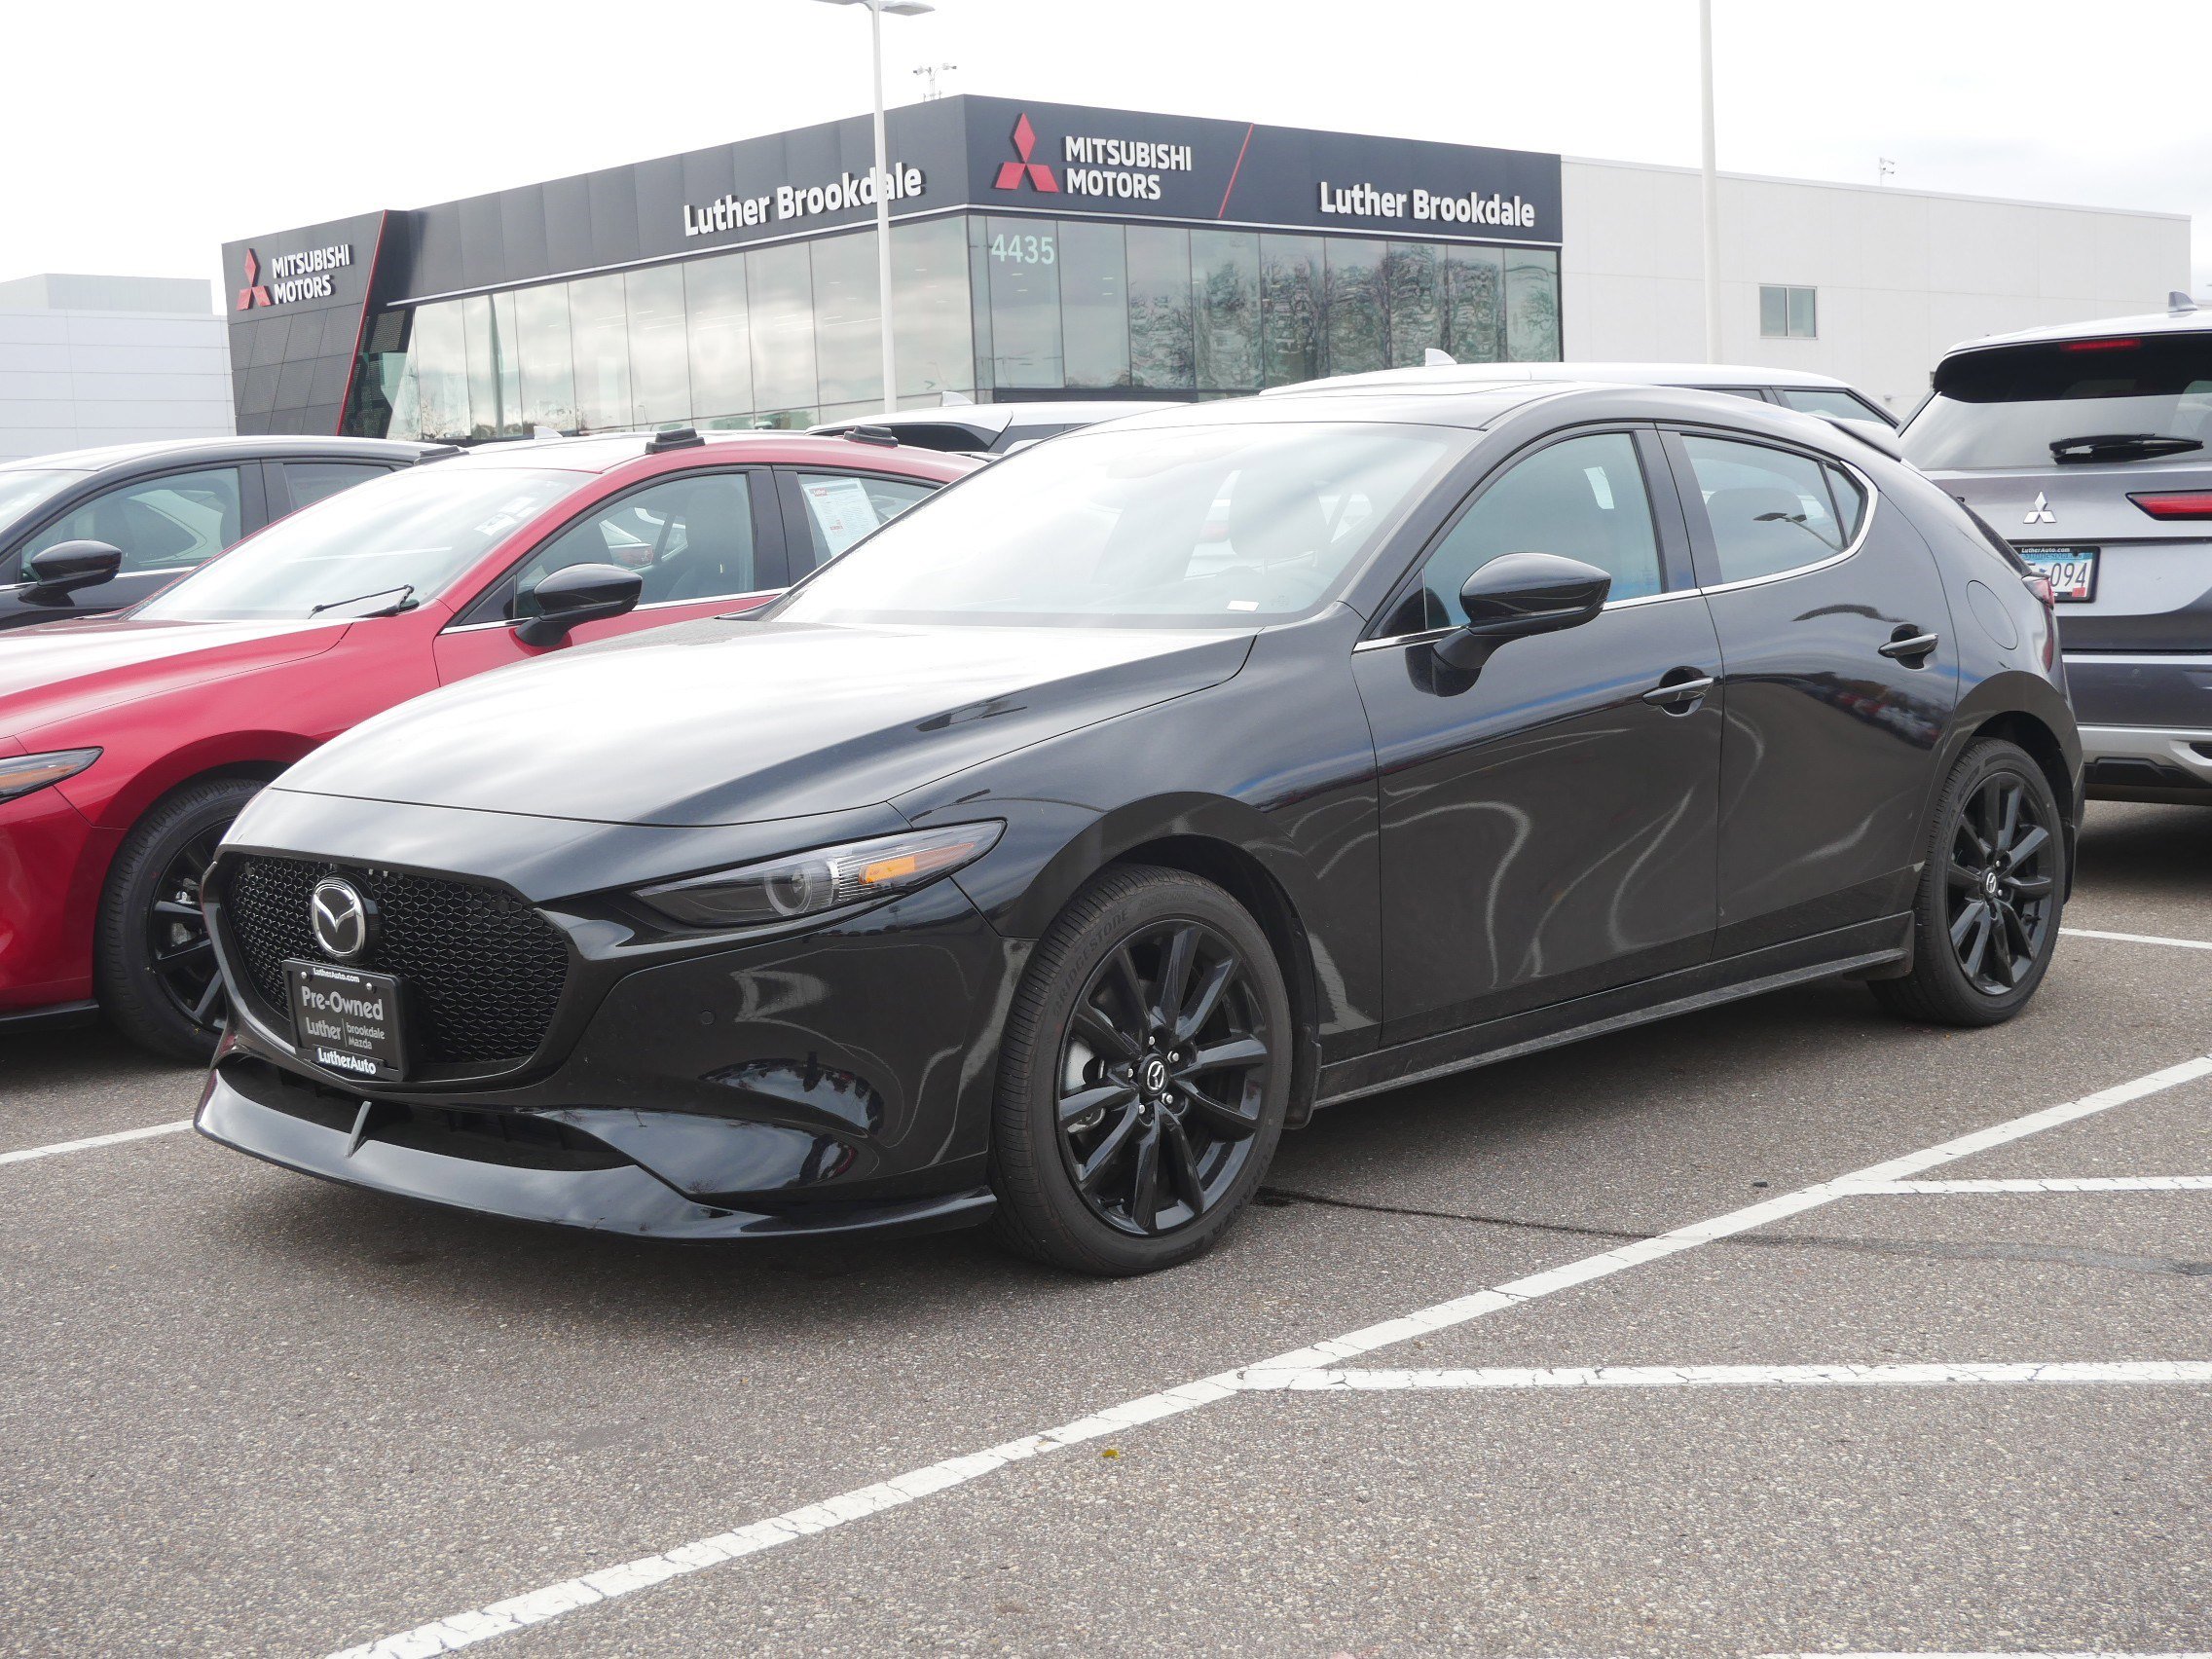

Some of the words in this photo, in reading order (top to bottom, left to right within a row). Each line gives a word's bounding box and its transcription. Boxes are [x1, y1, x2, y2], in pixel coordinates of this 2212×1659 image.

[1065, 135, 1193, 171] MITSUBISHI
[1066, 167, 1161, 201] MOTORS
[683, 194, 771, 238] Luther
[1319, 181, 1408, 218] Luther
[1412, 189, 1535, 228] Brookdale
[272, 243, 350, 279] MITSUBISHI
[991, 233, 1055, 265] 4435
[274, 274, 332, 305] MOTORS
[301, 985, 384, 1021] Pre-Owned
[306, 1016, 342, 1041] Luther
[349, 1037, 373, 1050] Mazda
[317, 1048, 377, 1075] LutherAuto
